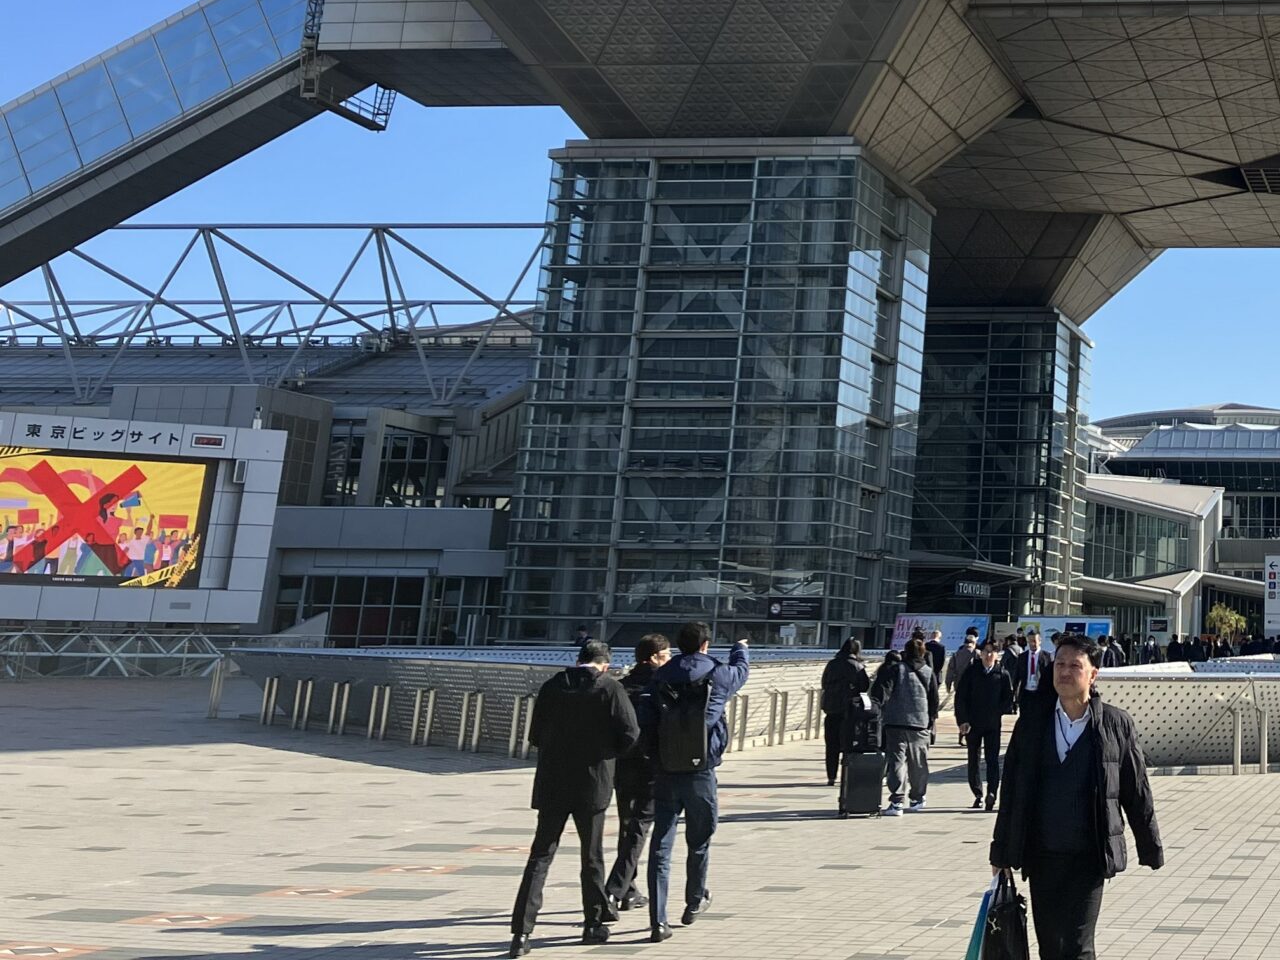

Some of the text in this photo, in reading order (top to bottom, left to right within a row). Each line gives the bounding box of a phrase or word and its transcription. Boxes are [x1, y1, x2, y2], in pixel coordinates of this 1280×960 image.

[26, 423, 179, 446] 東京ビッグサイト
[958, 582, 980, 595] TOKYO
